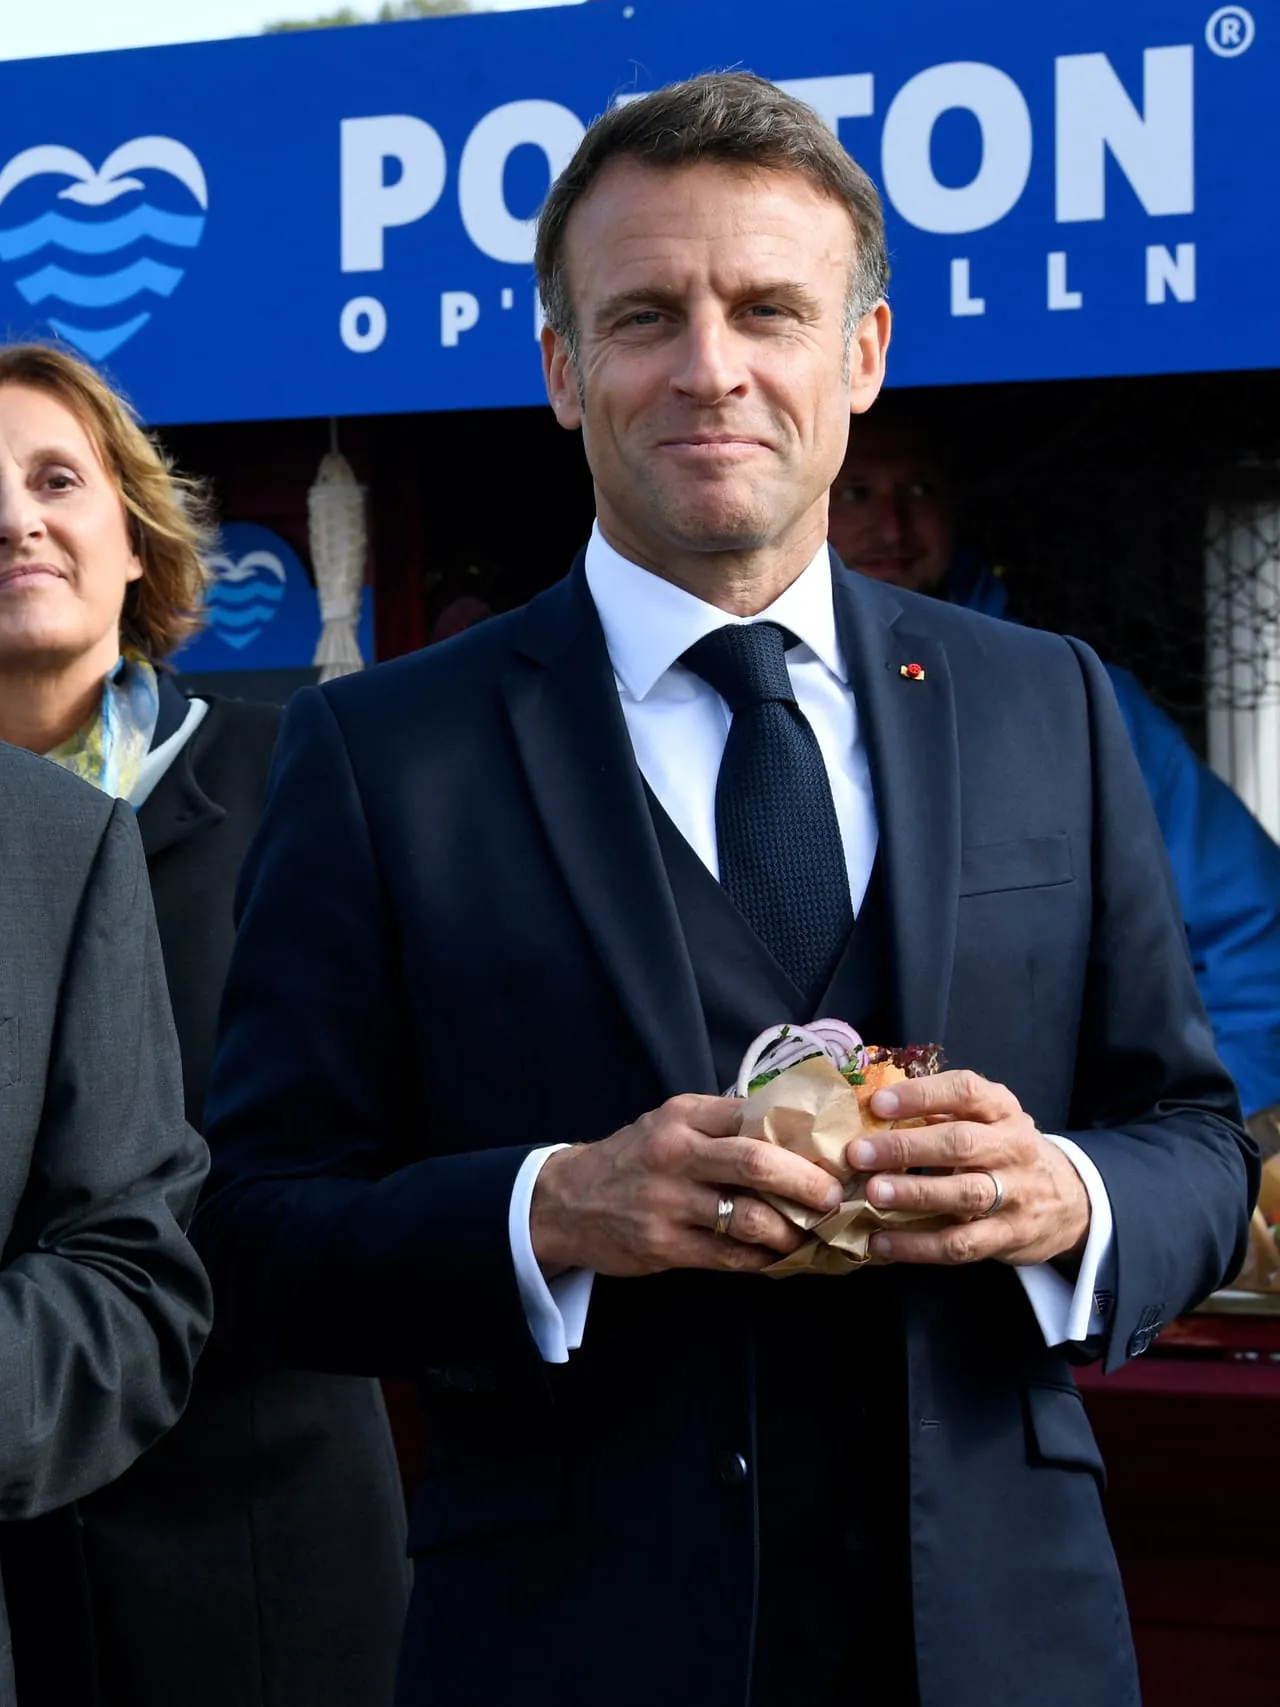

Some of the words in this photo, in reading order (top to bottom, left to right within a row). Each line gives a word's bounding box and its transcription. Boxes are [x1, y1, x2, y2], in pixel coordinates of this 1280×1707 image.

[340, 44, 1195, 273] POON
[339, 287, 549, 353] OP'
[950, 242, 1196, 316] LLN
